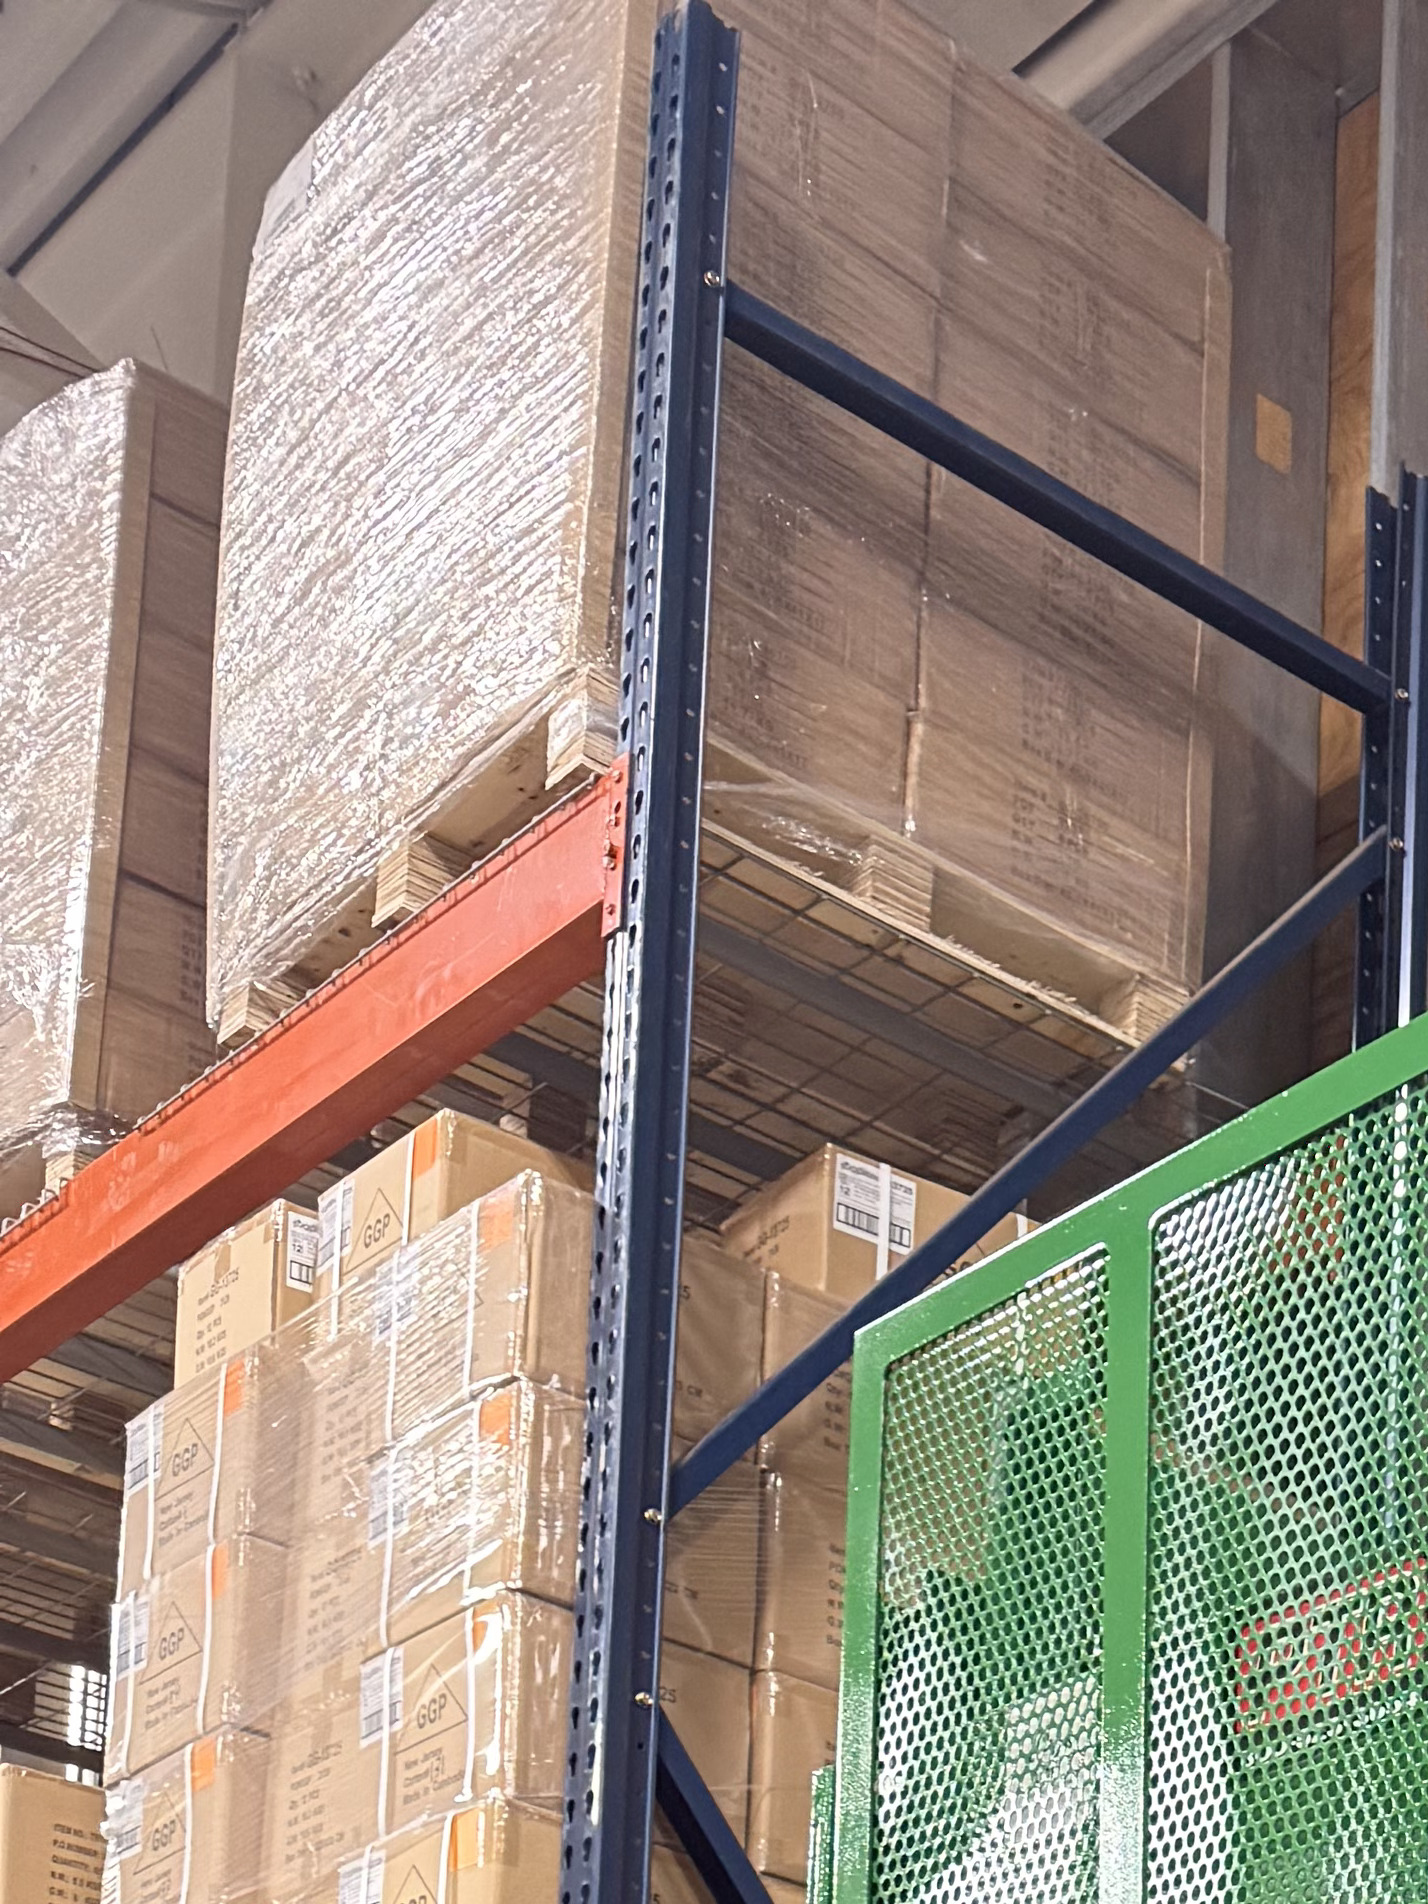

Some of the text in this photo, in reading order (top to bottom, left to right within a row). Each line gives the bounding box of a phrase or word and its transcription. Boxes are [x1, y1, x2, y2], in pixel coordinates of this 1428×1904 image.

[363, 1212, 391, 1249] GGP
[171, 1442, 198, 1477] GGP
[158, 1627, 185, 1661] GGP
[416, 1692, 447, 1730] GGP
